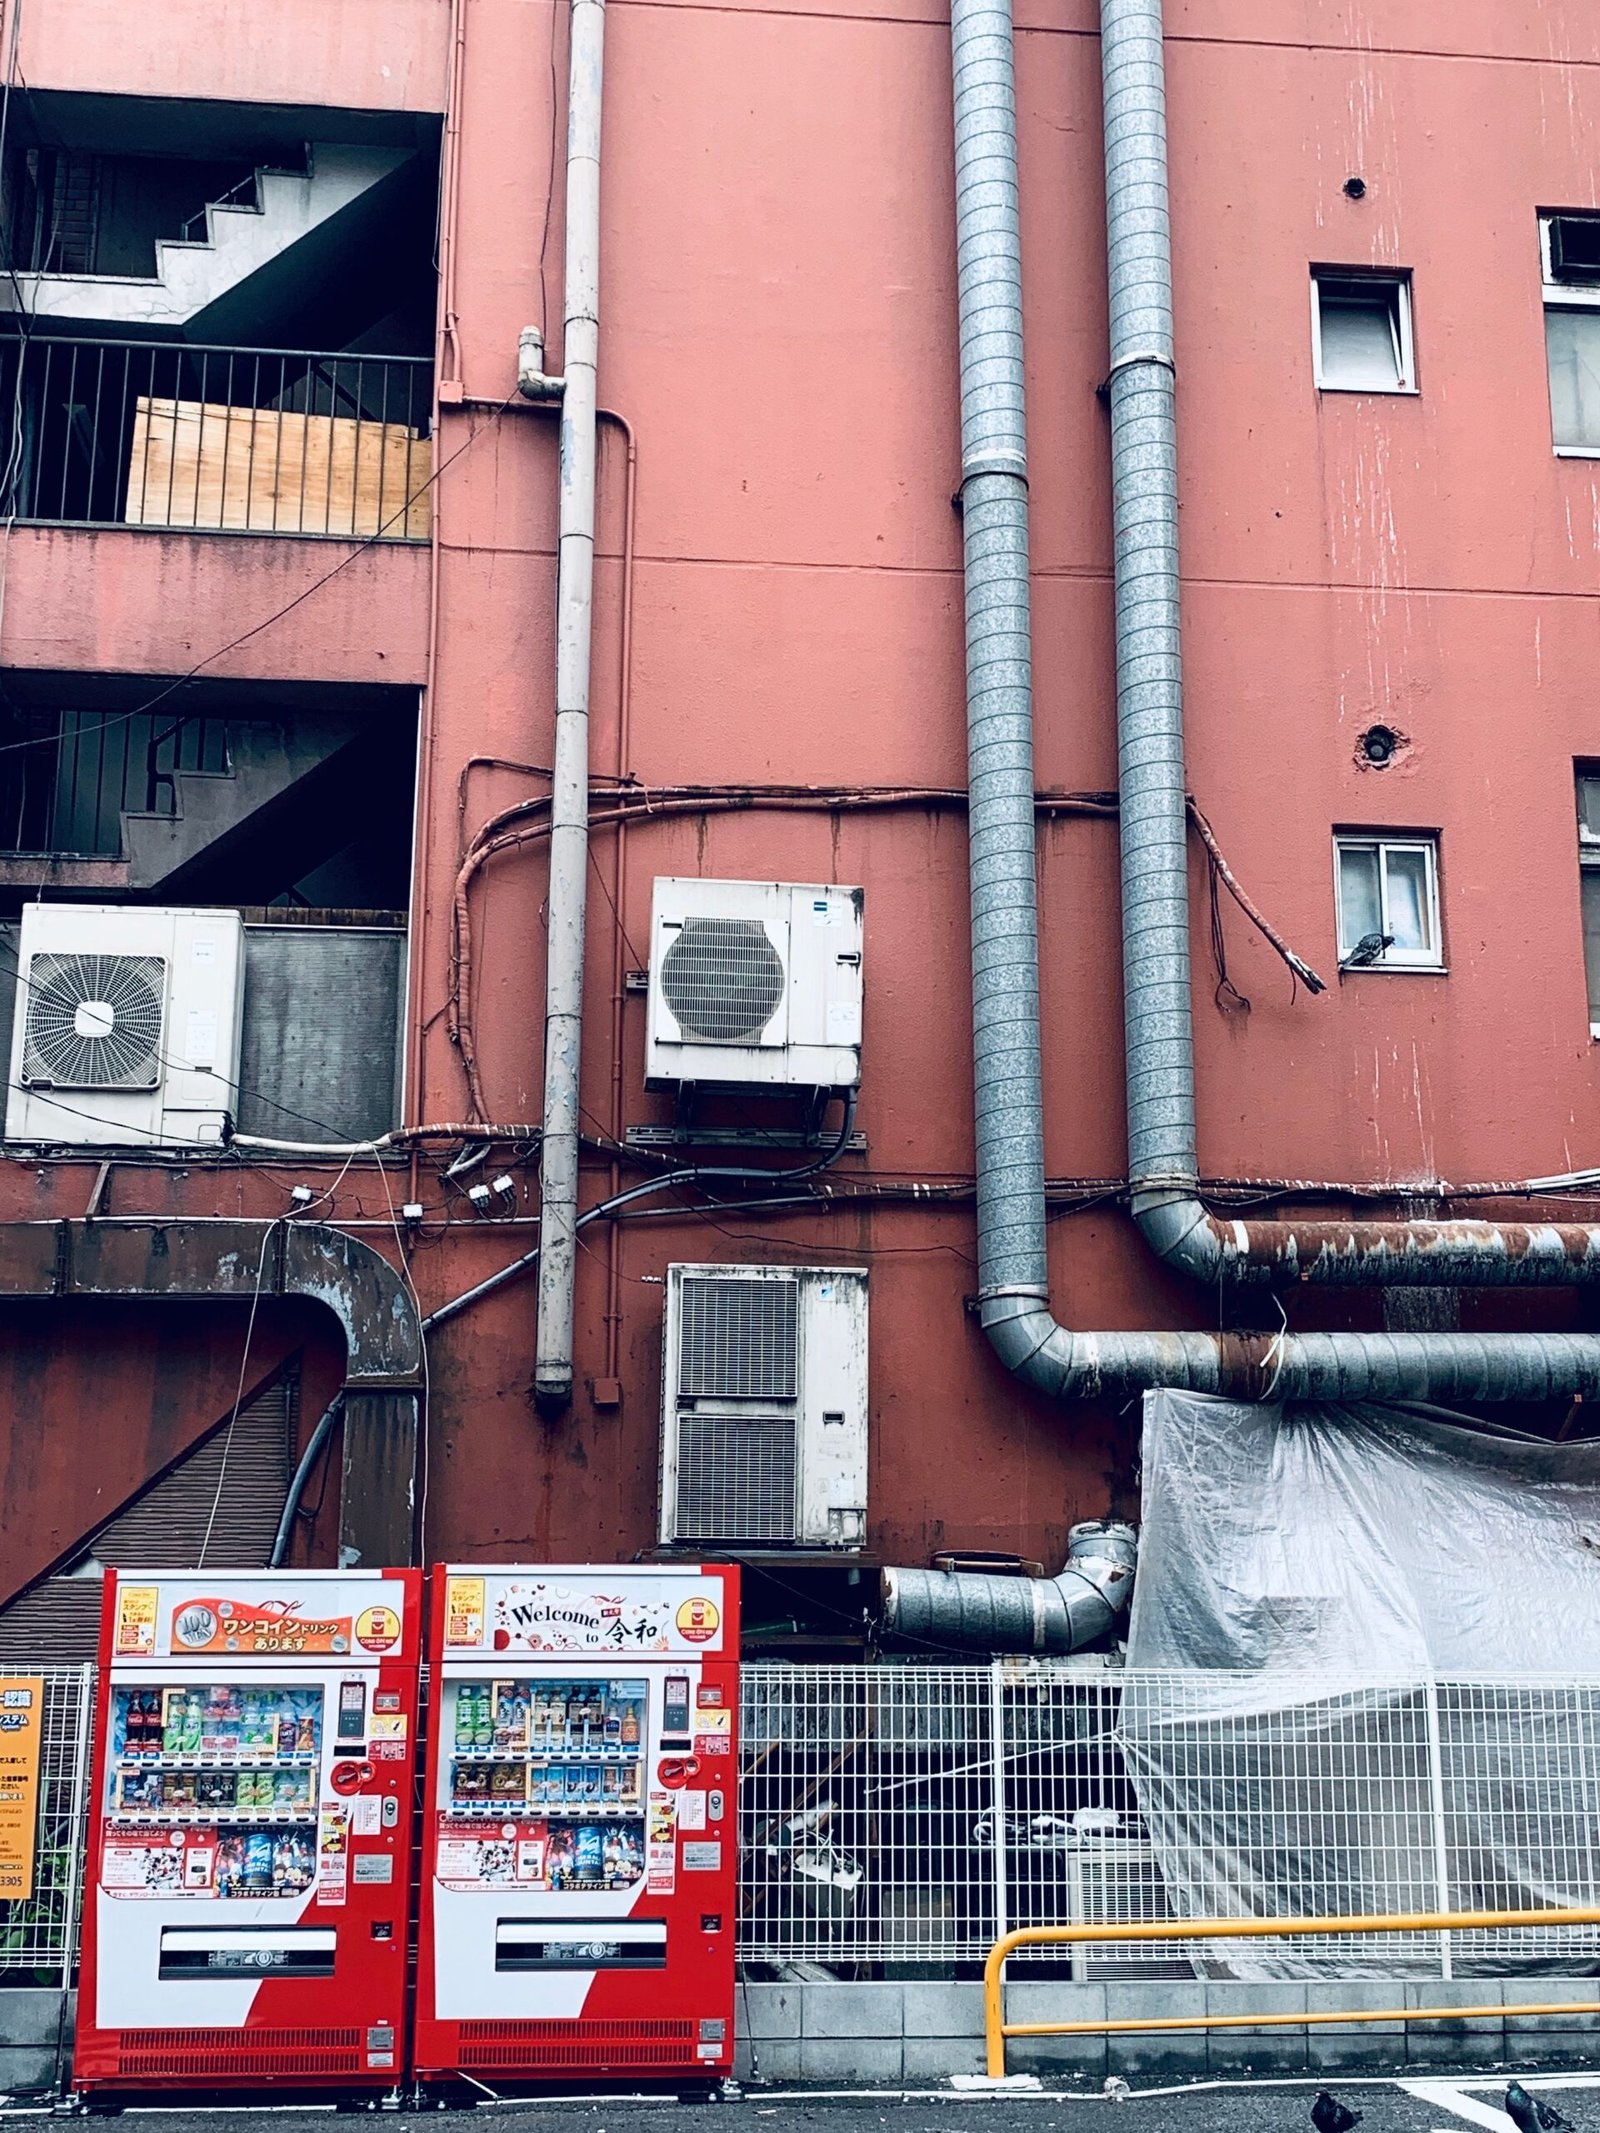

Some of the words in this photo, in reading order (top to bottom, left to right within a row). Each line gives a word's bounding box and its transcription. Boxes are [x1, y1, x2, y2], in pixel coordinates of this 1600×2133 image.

[511, 1602, 600, 1629] Welcome
[254, 1637, 306, 1651] あります
[586, 1632, 599, 1643] to
[605, 1618, 657, 1644] 令和
